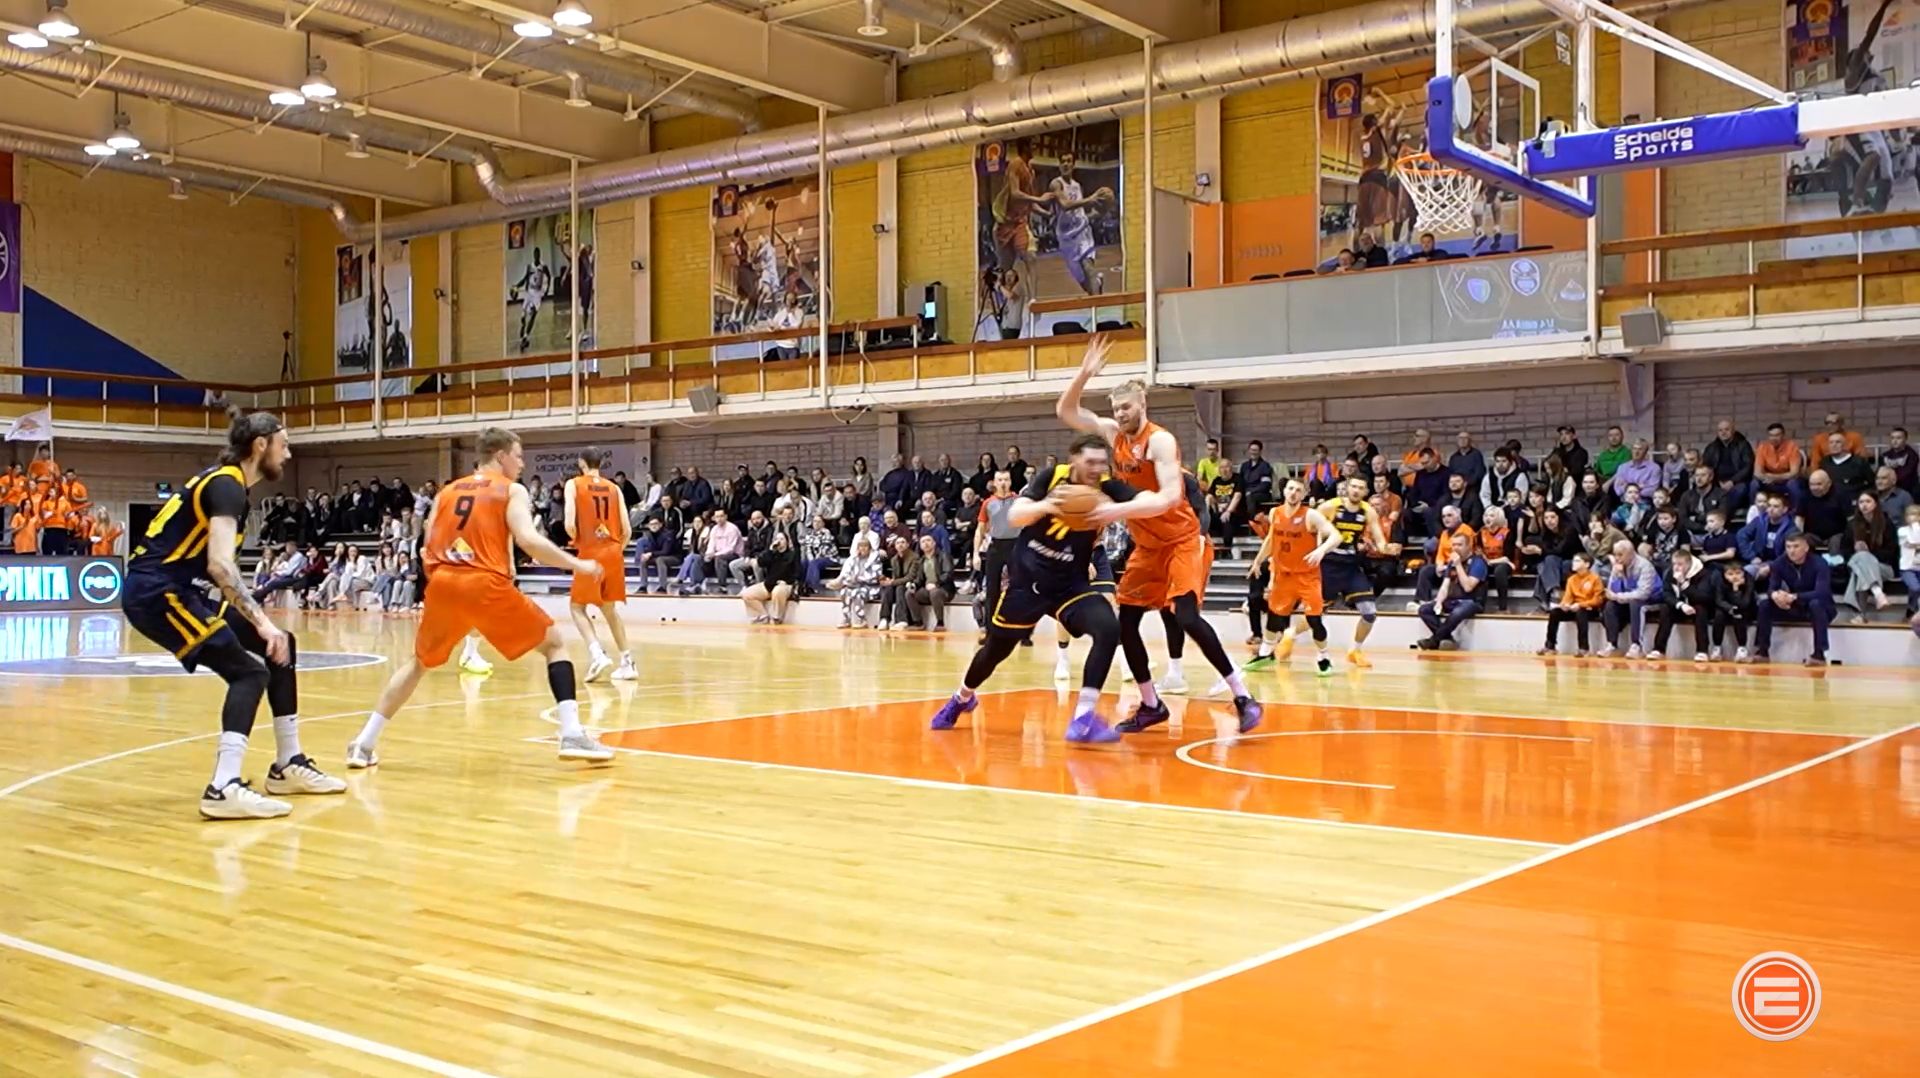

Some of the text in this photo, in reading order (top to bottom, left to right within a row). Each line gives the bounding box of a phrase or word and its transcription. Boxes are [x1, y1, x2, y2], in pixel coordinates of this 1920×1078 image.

[1614, 139, 1693, 161] Sports
[455, 495, 475, 530] 9
[593, 496, 609, 520] 11
